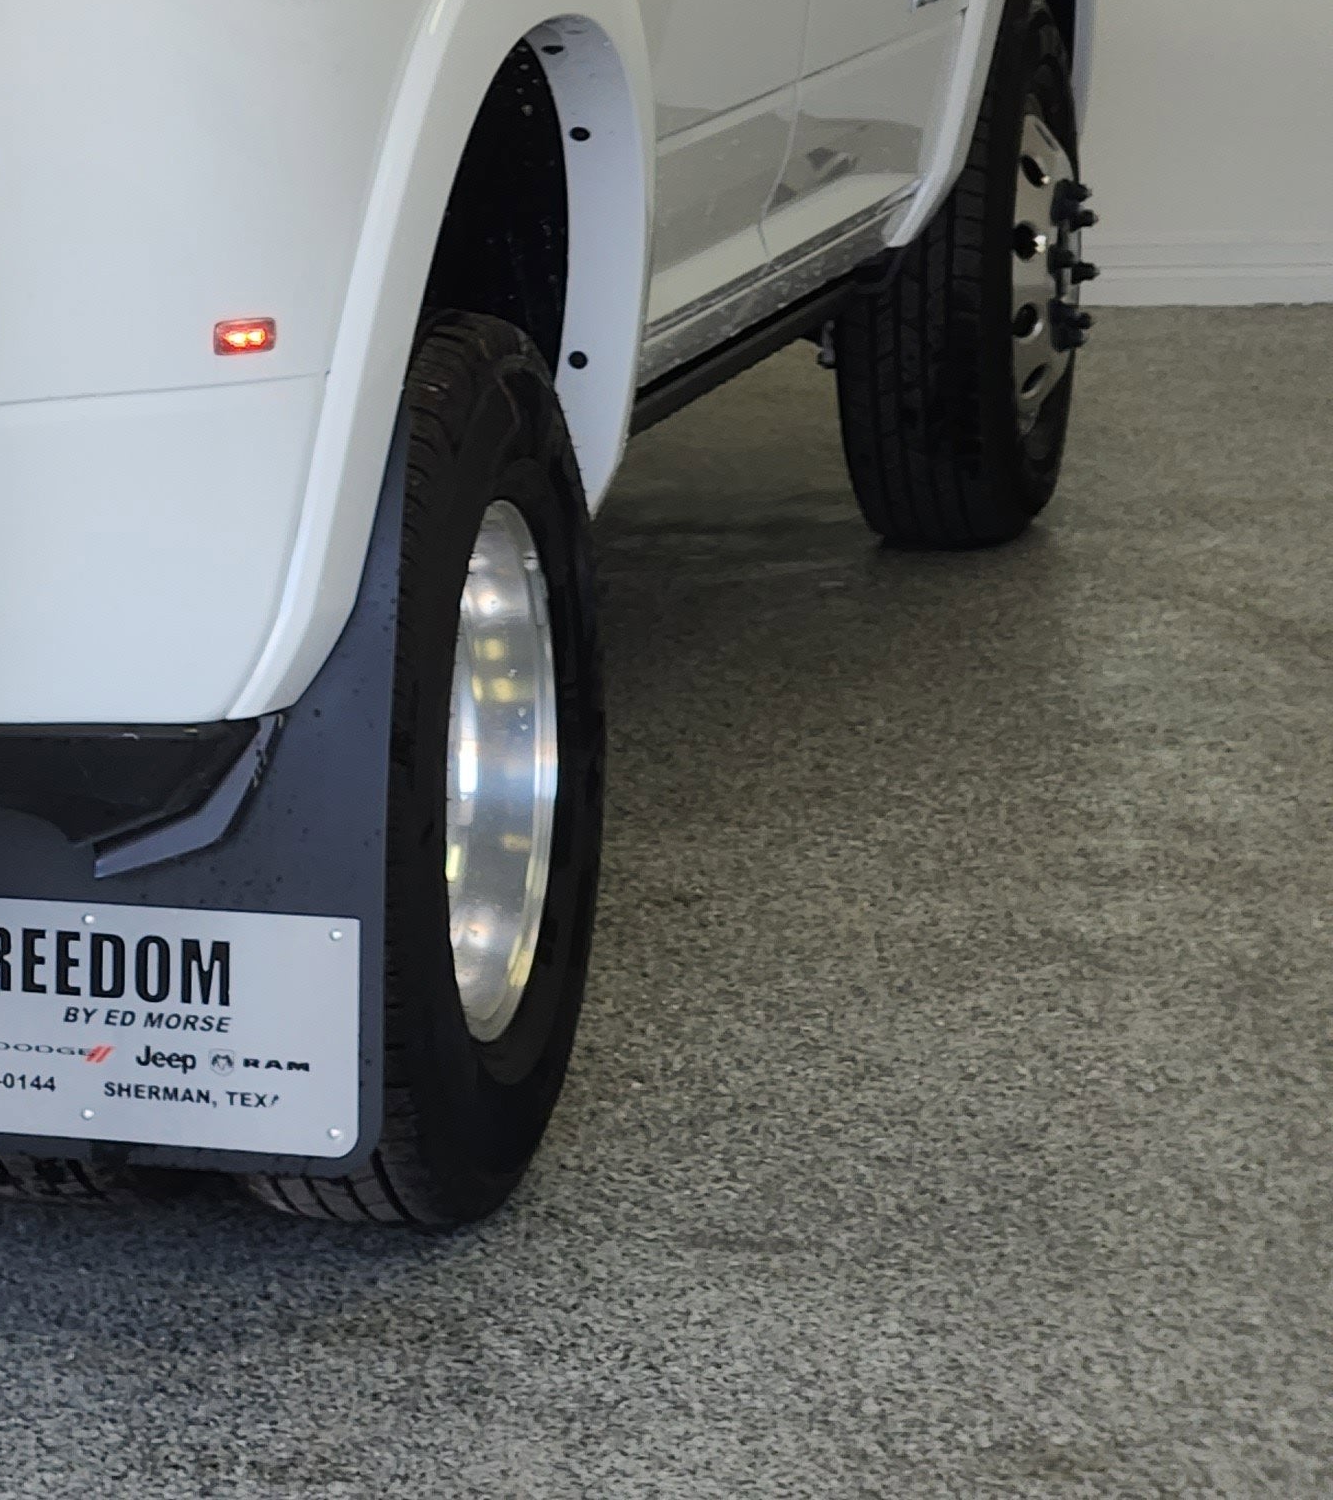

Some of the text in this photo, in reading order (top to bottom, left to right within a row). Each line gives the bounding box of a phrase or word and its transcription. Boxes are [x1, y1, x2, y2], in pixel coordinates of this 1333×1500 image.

[63, 1006, 231, 1034] BY ED MORSE
[136, 1045, 197, 1074] Jeep
[242, 1057, 311, 1072] RAM
[104, 1081, 218, 1108] SHERMAN,
